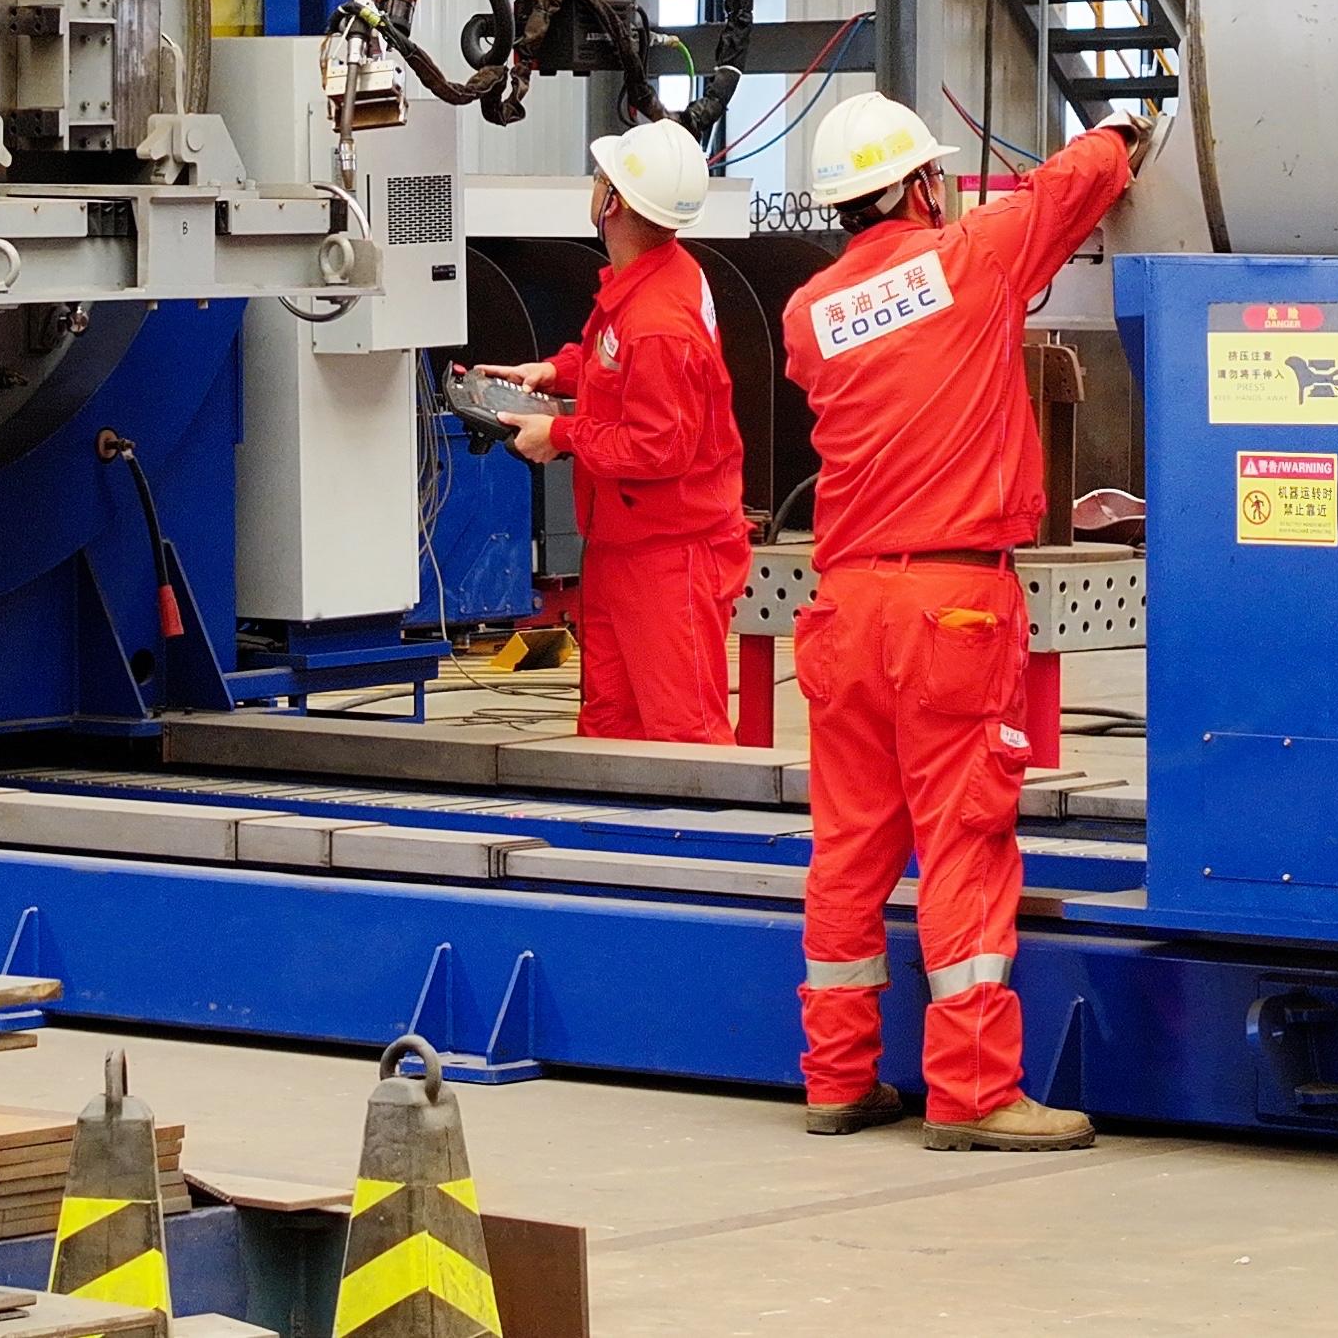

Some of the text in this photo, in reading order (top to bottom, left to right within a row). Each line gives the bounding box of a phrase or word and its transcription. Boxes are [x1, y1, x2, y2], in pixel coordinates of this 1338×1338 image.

[182, 221, 188, 236] B
[825, 266, 928, 327] 海油工程
[831, 288, 936, 344] COOEC
[1264, 320, 1301, 328] DANGER
[1236, 383, 1266, 391] PRESS
[1278, 486, 1333, 500] 机器运转时
[1284, 503, 1327, 517] 禁止靠近
